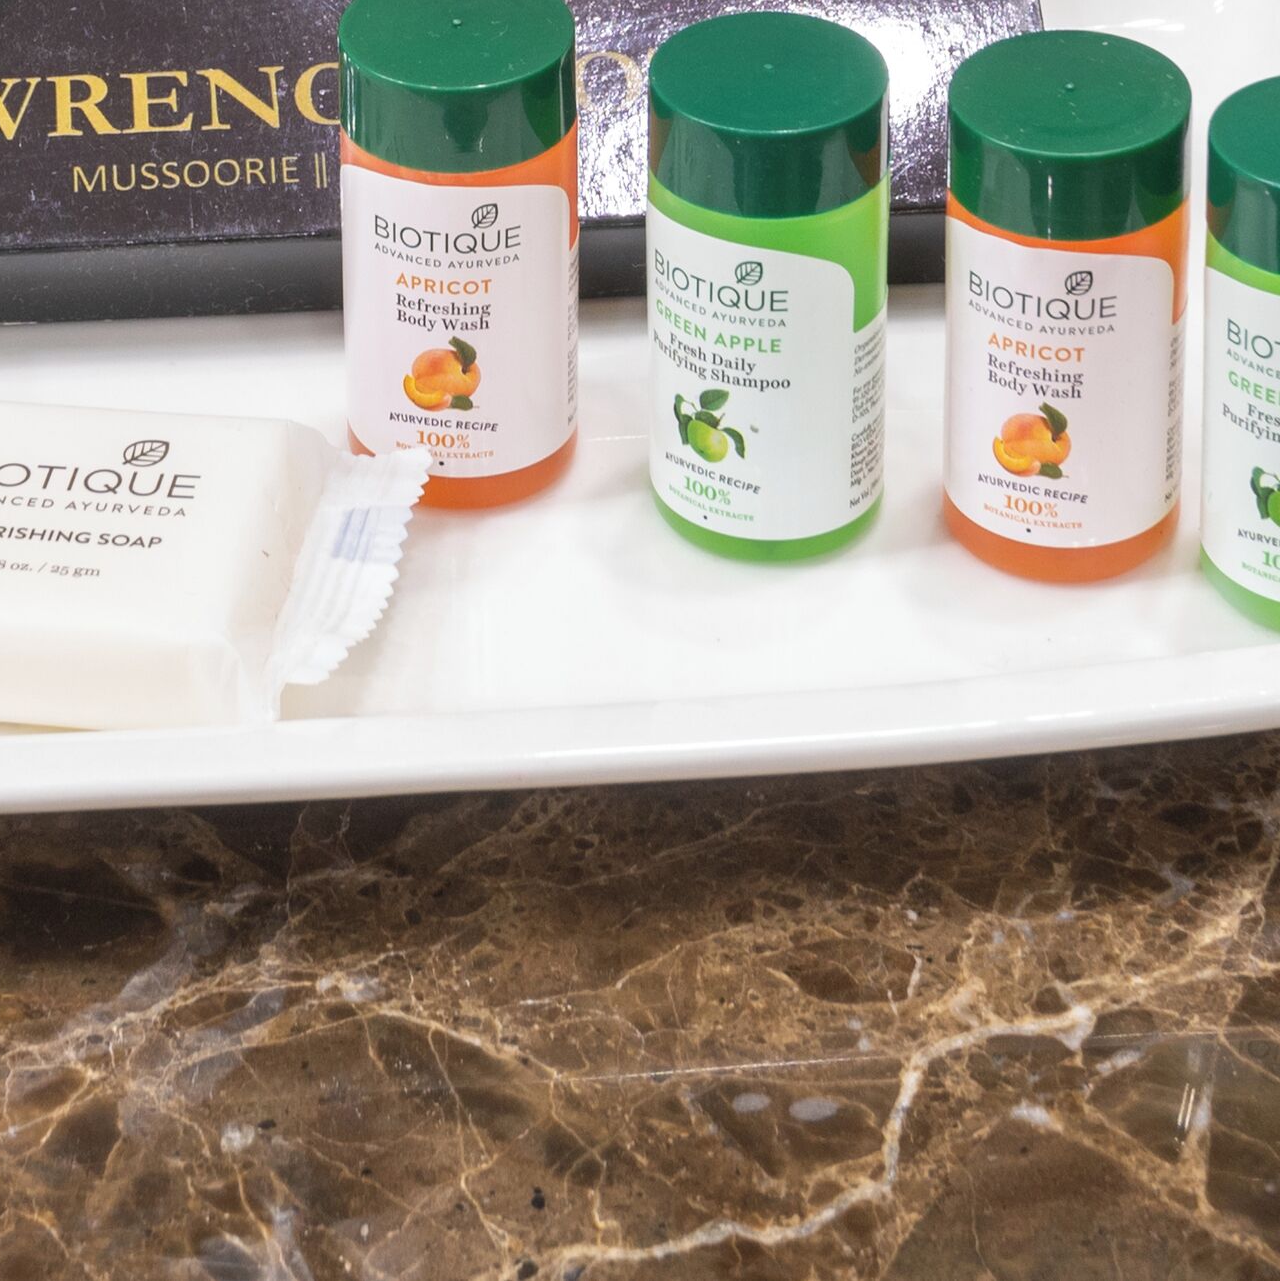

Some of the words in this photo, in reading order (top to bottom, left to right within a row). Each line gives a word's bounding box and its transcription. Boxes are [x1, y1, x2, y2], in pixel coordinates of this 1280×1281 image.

[73, 156, 300, 193] MUSSOORIE
[374, 215, 521, 254] BIOTIQUE
[374, 243, 442, 268] ADVANCED
[448, 253, 519, 269] AYURVEDA
[396, 272, 492, 295] APRICOT
[654, 248, 789, 312] BIOTIQUE
[969, 270, 1118, 320] BIOTIQUE
[396, 293, 491, 317] Refreshing
[654, 278, 707, 316] ADVANCED
[712, 311, 787, 328] AYURVEDA
[969, 299, 1033, 332] ADVANCED
[1039, 323, 1115, 336] AYURVEDA
[396, 309, 436, 331] Body
[442, 314, 489, 331] Wash
[656, 298, 707, 341] GREEN
[714, 332, 782, 353] APPLE
[653, 328, 707, 380] Purifying
[711, 369, 791, 392] Shampoo
[670, 332, 707, 362] Fresh
[712, 352, 756, 375] Daily
[988, 332, 1085, 363] APRICOT
[987, 353, 1084, 387] Refreshing
[988, 370, 1026, 396] Body
[1032, 382, 1082, 399] Wash
[389, 411, 452, 429] AYURVEDIC
[456, 420, 498, 433] RECIPE
[416, 430, 470, 449] 100%
[665, 451, 716, 483] AYURVEDIC
[718, 471, 760, 495] RECIPE
[978, 472, 1040, 496] AYURVEDIC
[1043, 487, 1088, 504] RECIPE
[683, 474, 731, 506] 100%
[65, 500, 187, 517] AYURVEDA
[1003, 494, 1058, 519] 100%
[97, 533, 163, 549] SOAP
[72, 567, 101, 578] gm
